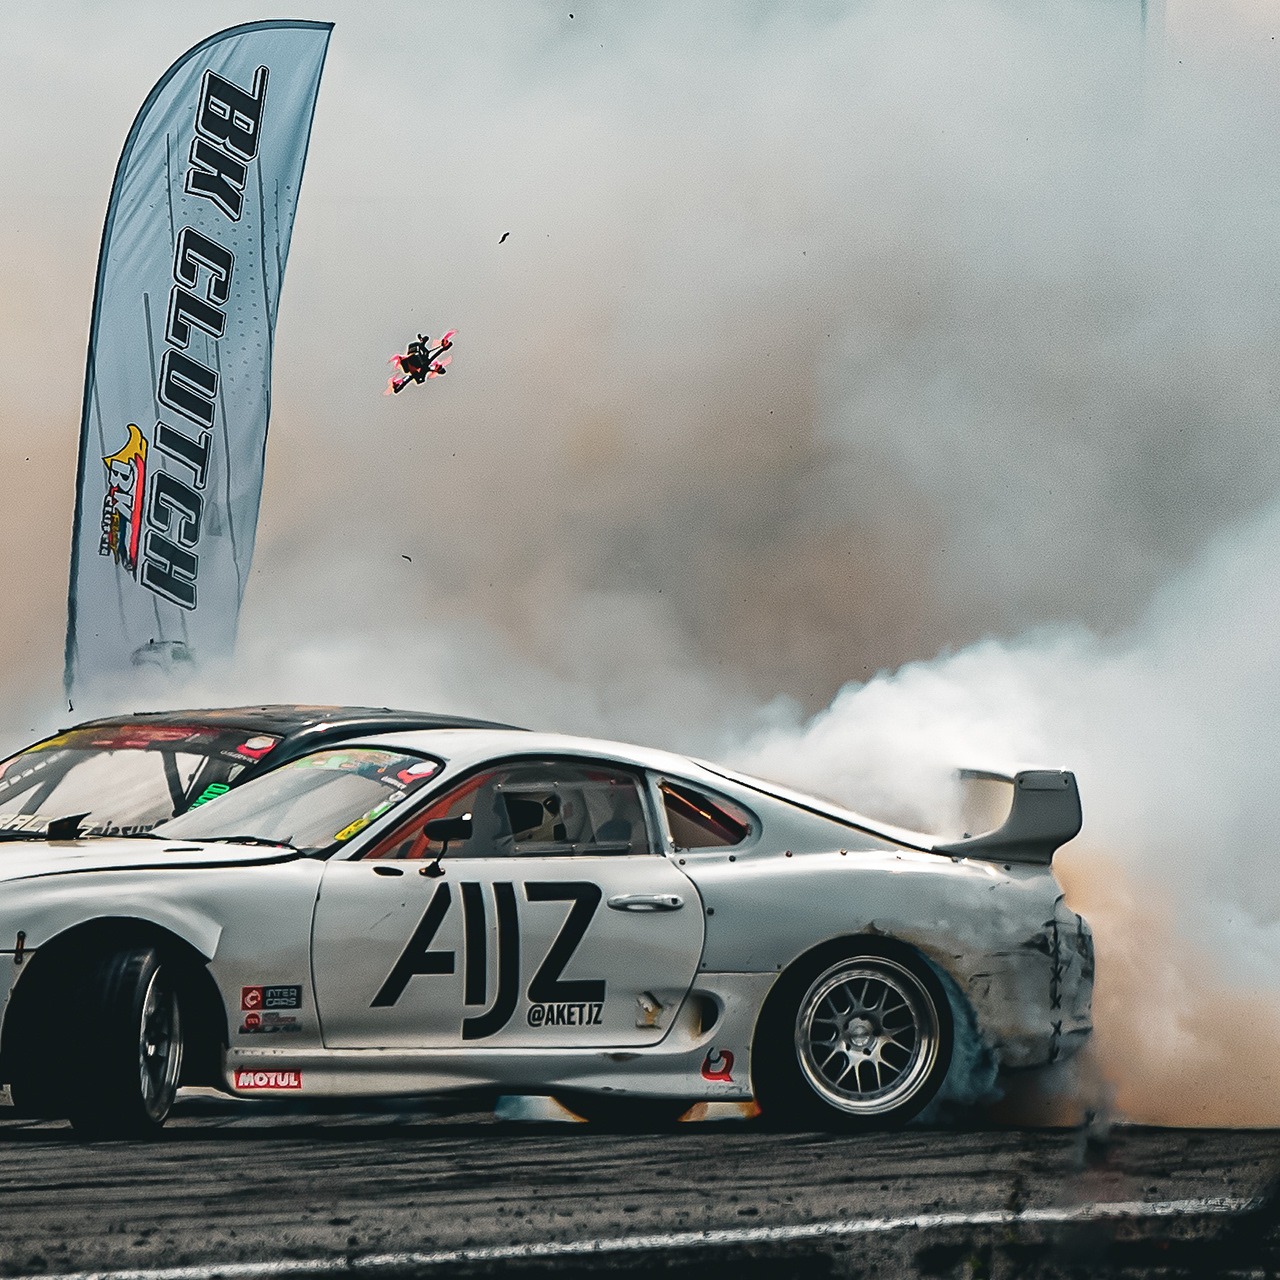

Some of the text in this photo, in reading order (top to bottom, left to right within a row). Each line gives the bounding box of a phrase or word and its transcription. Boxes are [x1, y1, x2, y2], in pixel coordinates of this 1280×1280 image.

[141, 64, 270, 613] BK CLUTCH
[266, 988, 297, 998] INTER
[266, 997, 297, 1007] CARS
[238, 1072, 299, 1086] MOTUL
